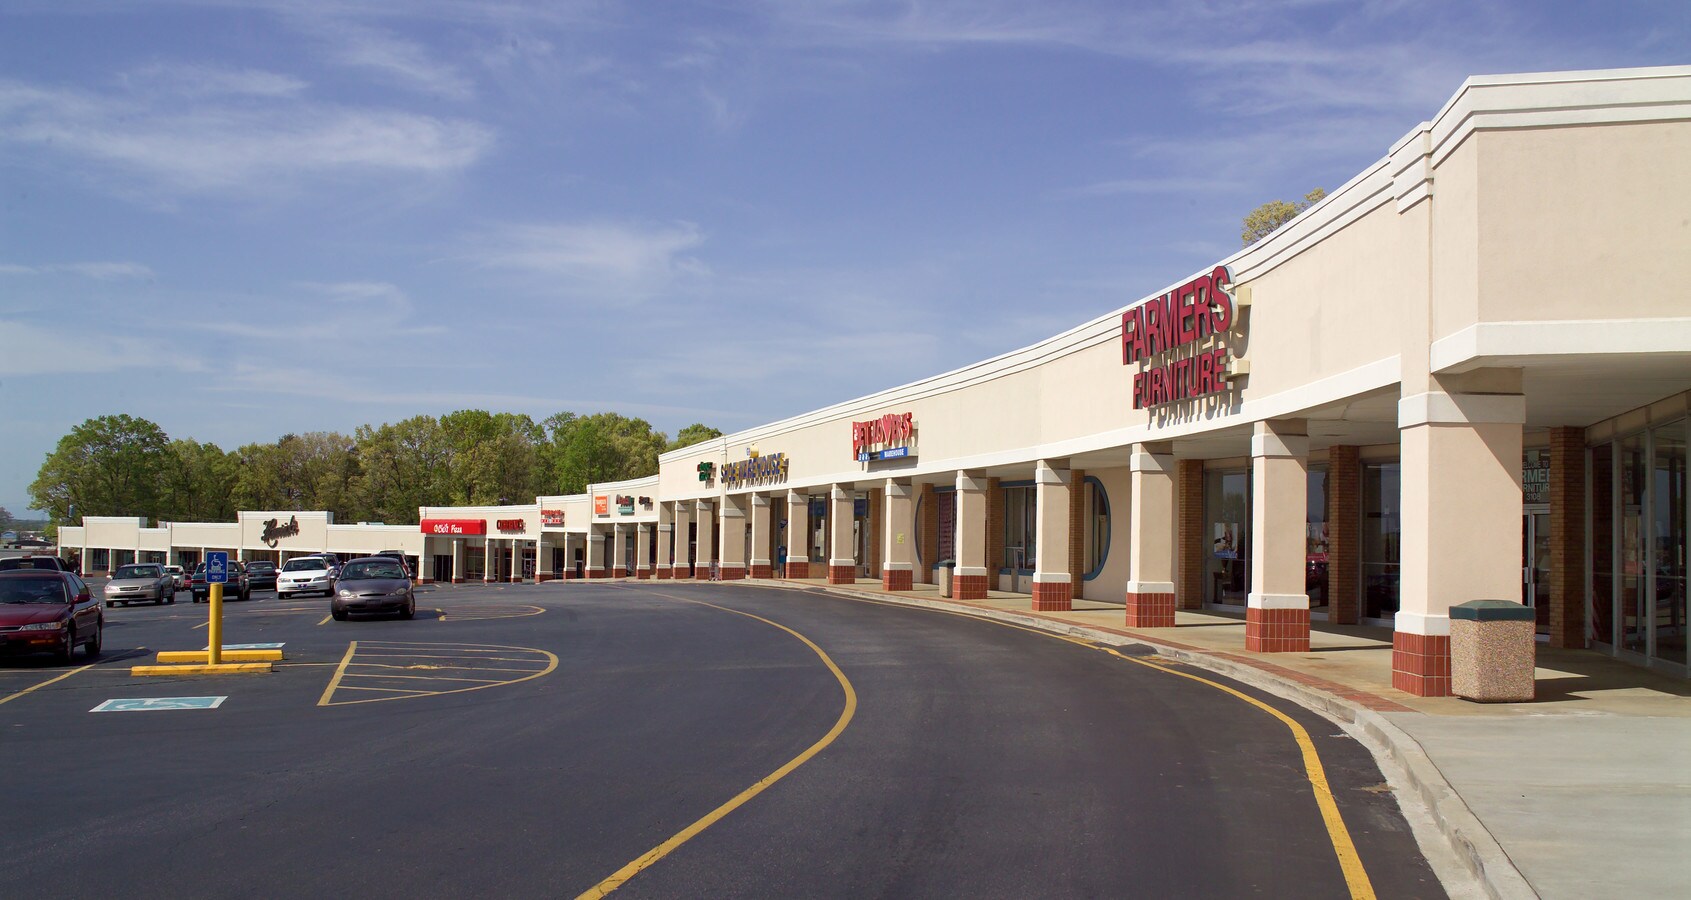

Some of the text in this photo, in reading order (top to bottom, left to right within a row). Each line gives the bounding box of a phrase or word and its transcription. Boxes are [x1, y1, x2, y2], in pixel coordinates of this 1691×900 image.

[1122, 265, 1236, 365] FARMERS
[1133, 348, 1228, 410] FURNITURE
[884, 449, 904, 458] WAREHOUSE
[739, 452, 785, 480] WAREHOUSE
[1523, 461, 1541, 469] ELCOME
[1523, 483, 1550, 493] RNITUR
